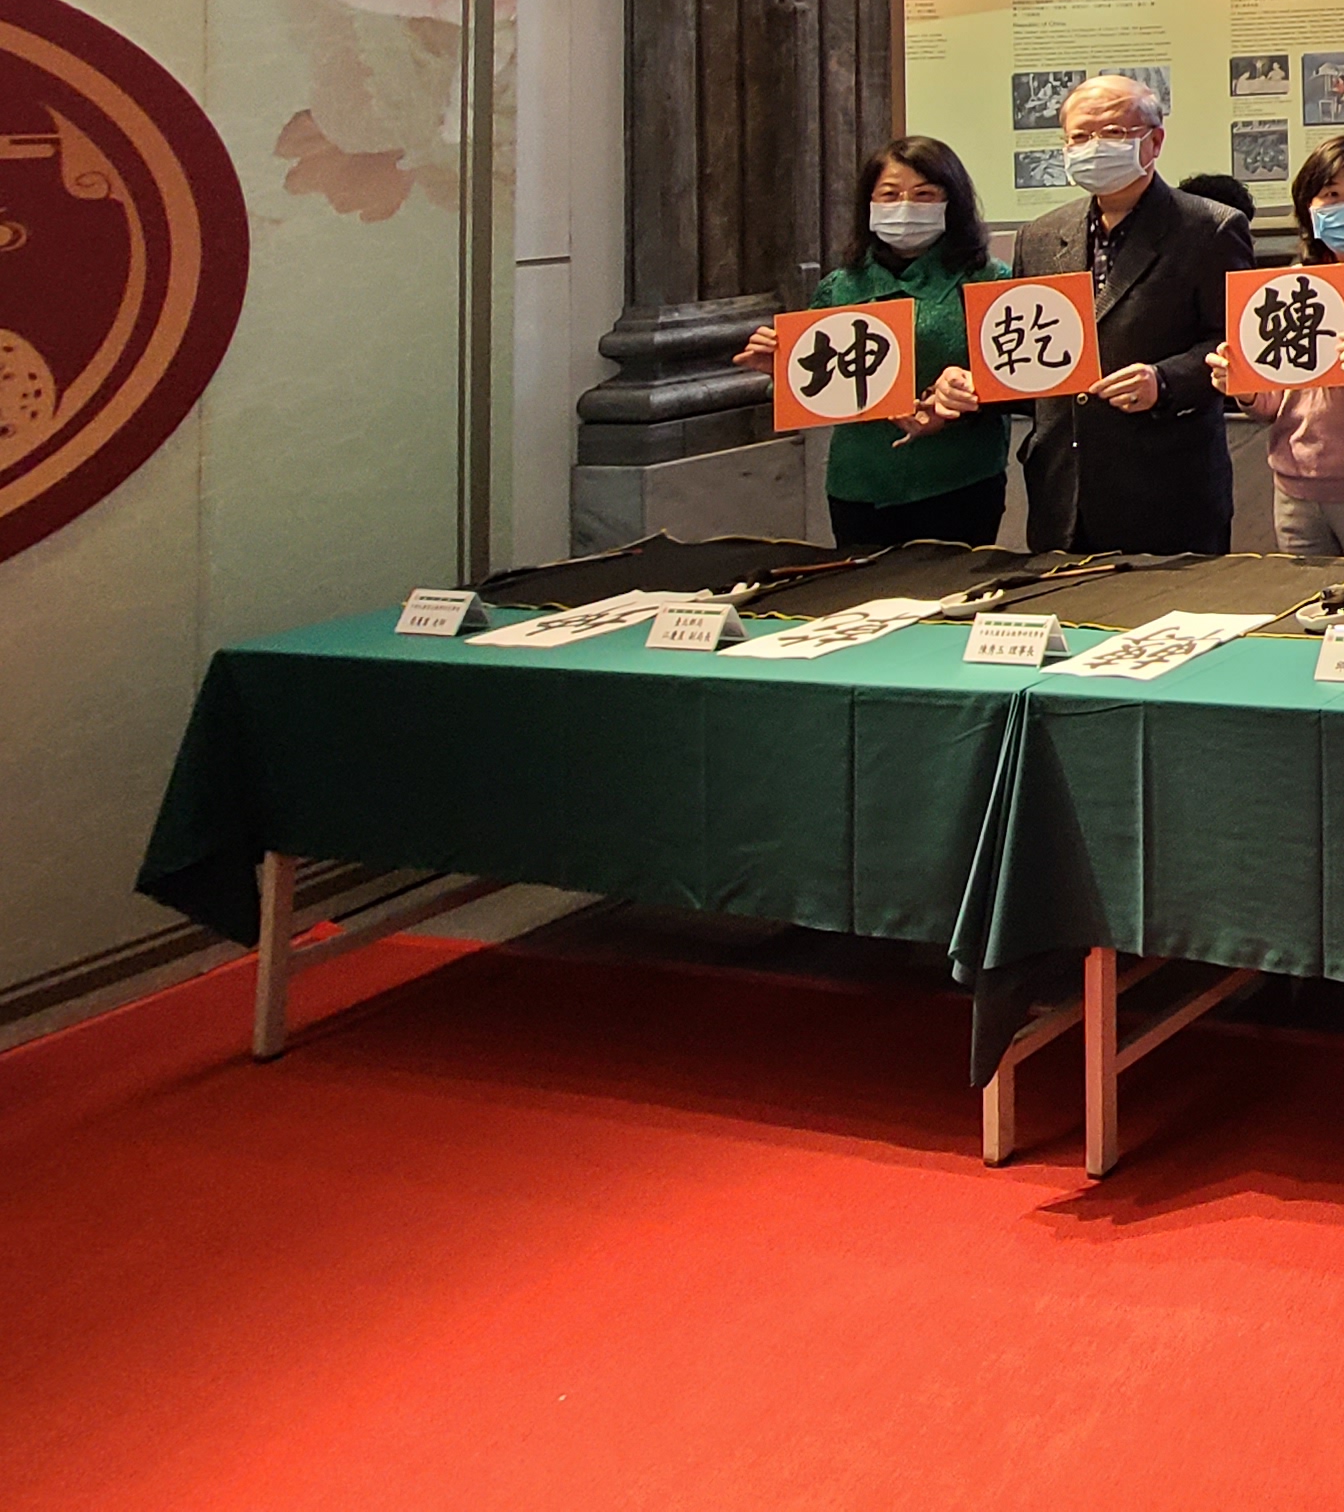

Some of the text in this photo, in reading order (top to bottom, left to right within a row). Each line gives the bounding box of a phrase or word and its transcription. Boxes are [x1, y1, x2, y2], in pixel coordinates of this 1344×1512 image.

[796, 319, 890, 410] 坤
[990, 304, 1071, 375] 乾
[1253, 276, 1337, 371] 轉
